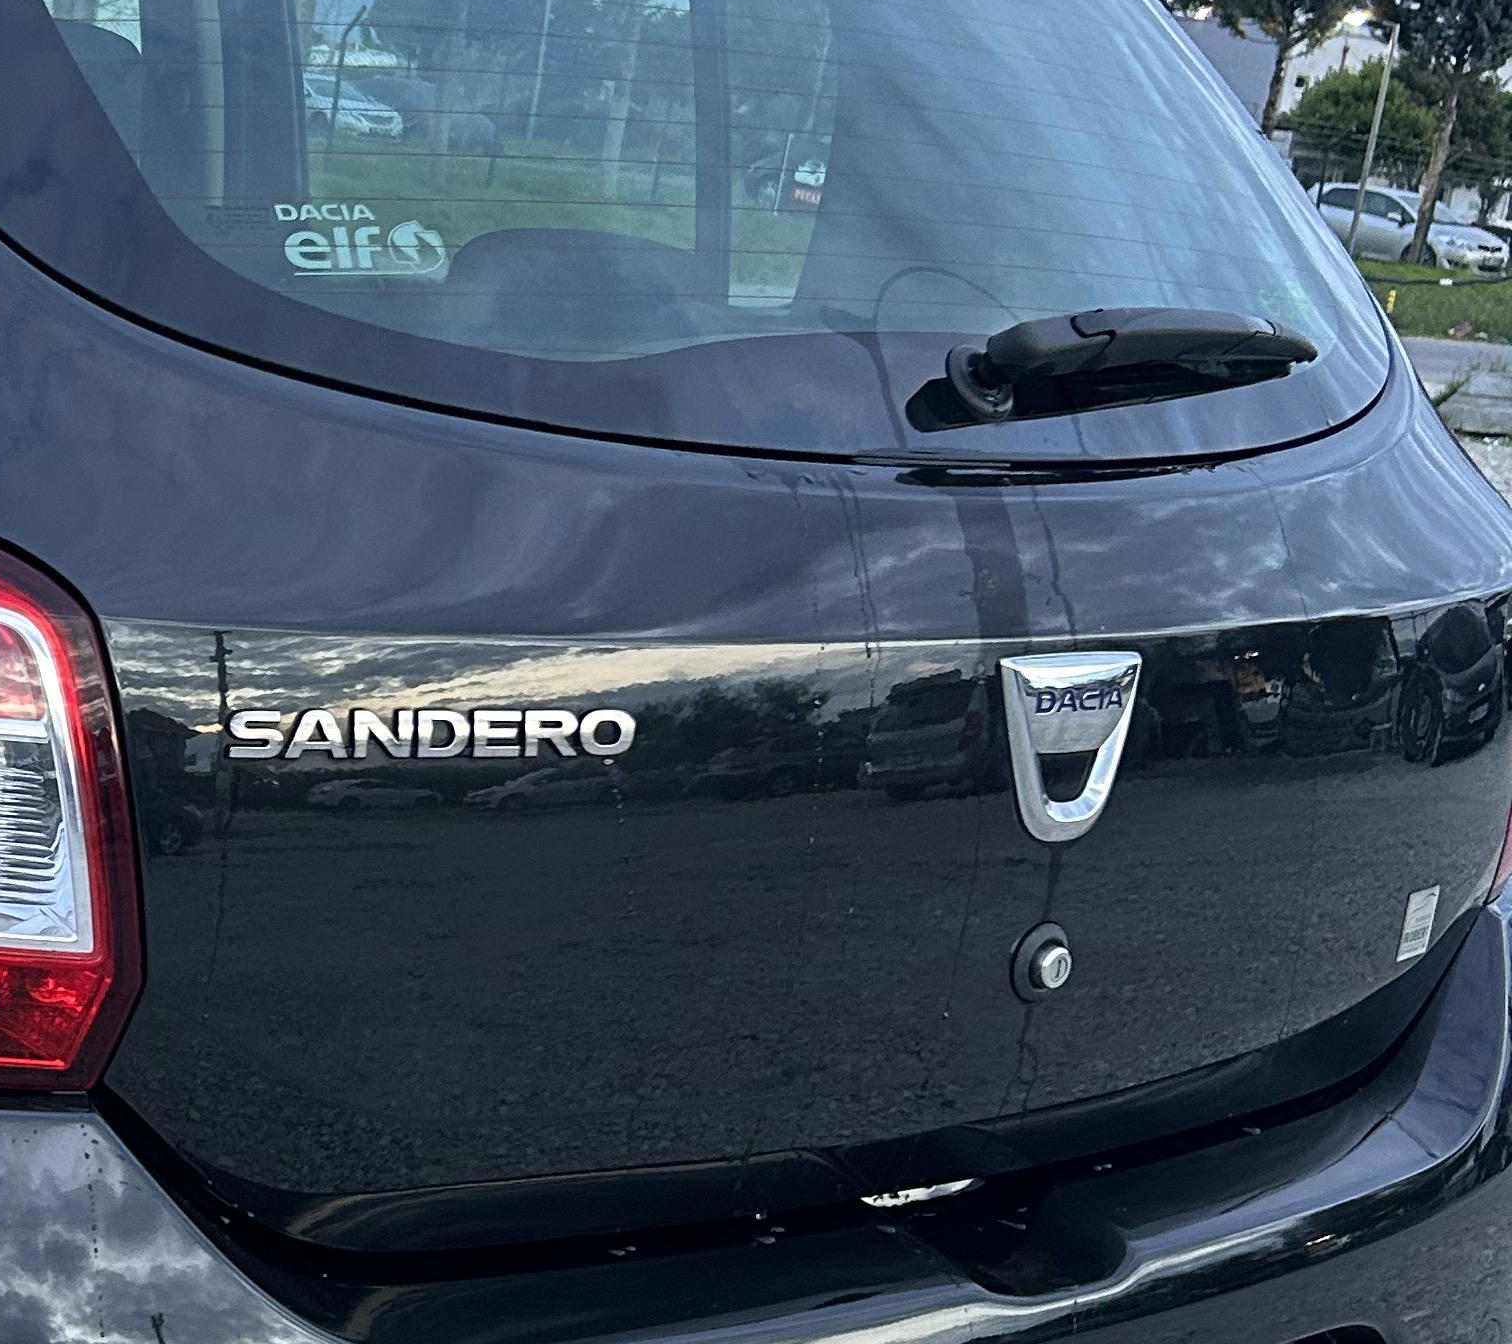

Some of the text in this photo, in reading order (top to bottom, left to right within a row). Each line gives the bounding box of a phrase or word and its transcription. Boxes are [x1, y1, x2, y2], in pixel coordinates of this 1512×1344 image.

[273, 203, 376, 221] DACIA
[284, 226, 380, 269] elf
[1035, 687, 1123, 715] DACIA
[228, 709, 636, 758] SANDERO
